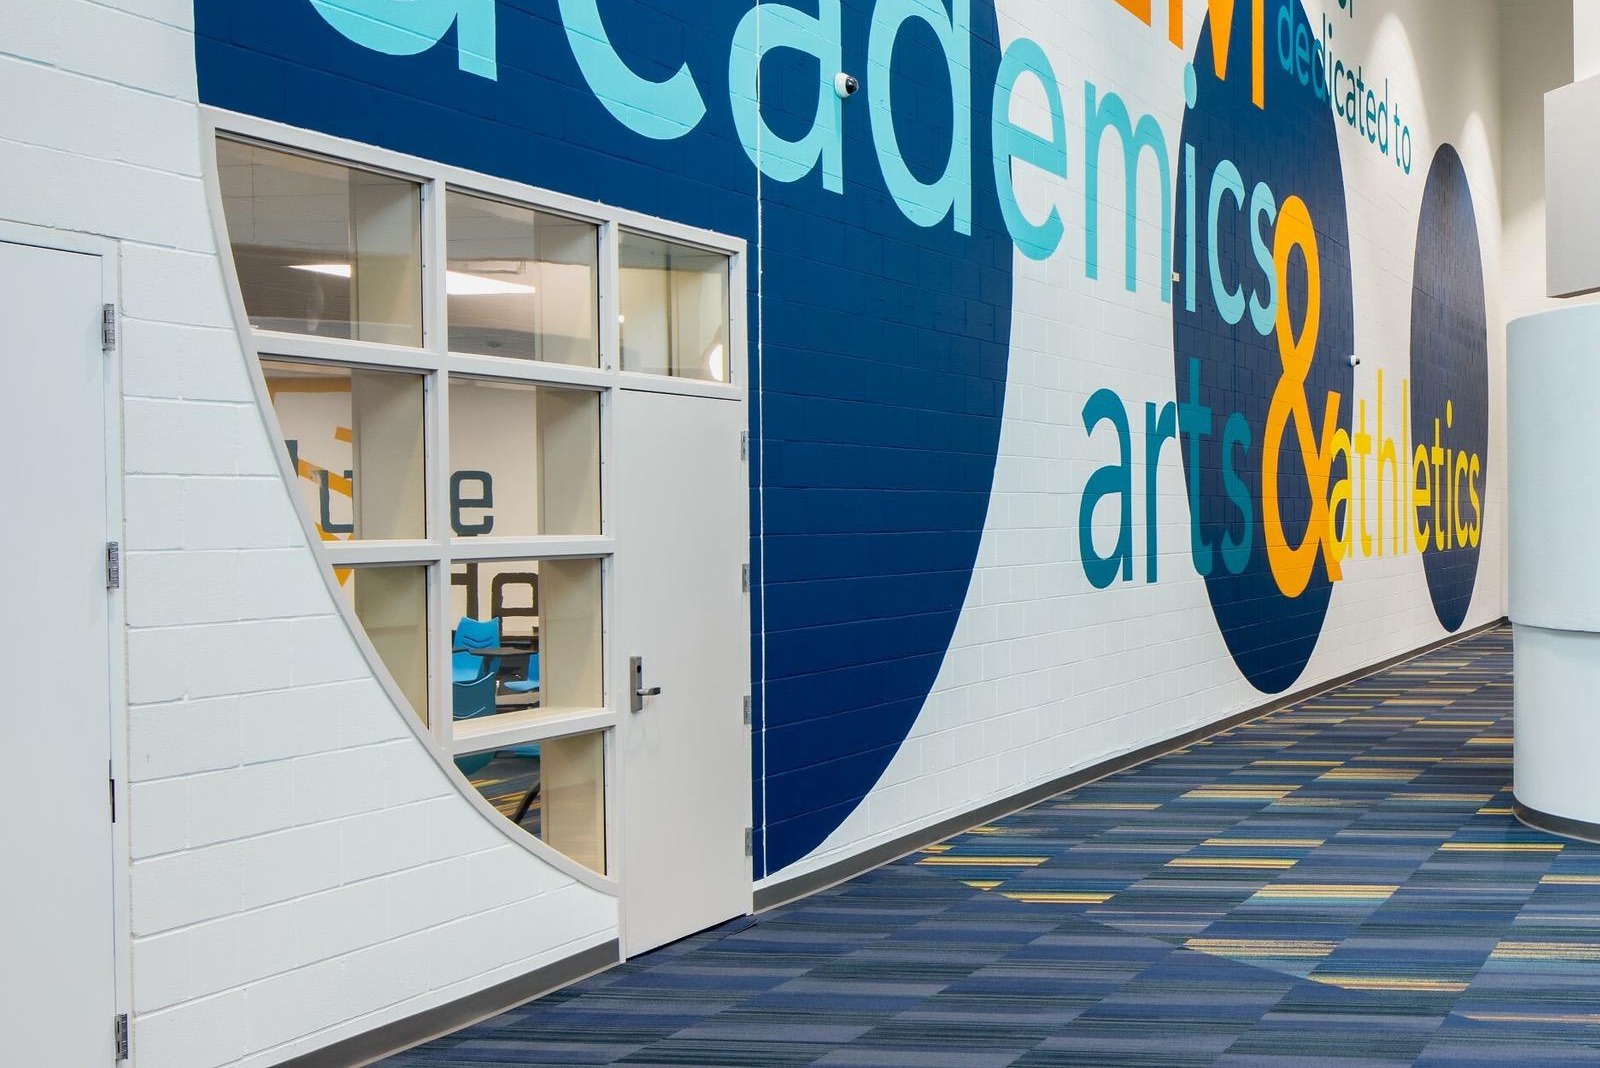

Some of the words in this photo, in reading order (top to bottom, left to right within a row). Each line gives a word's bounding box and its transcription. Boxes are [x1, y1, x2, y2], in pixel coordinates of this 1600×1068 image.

[1393, 100, 1413, 176] to
[1078, 355, 1255, 590] arts
[1261, 194, 1345, 599] &
[1327, 368, 1482, 563] athletics
